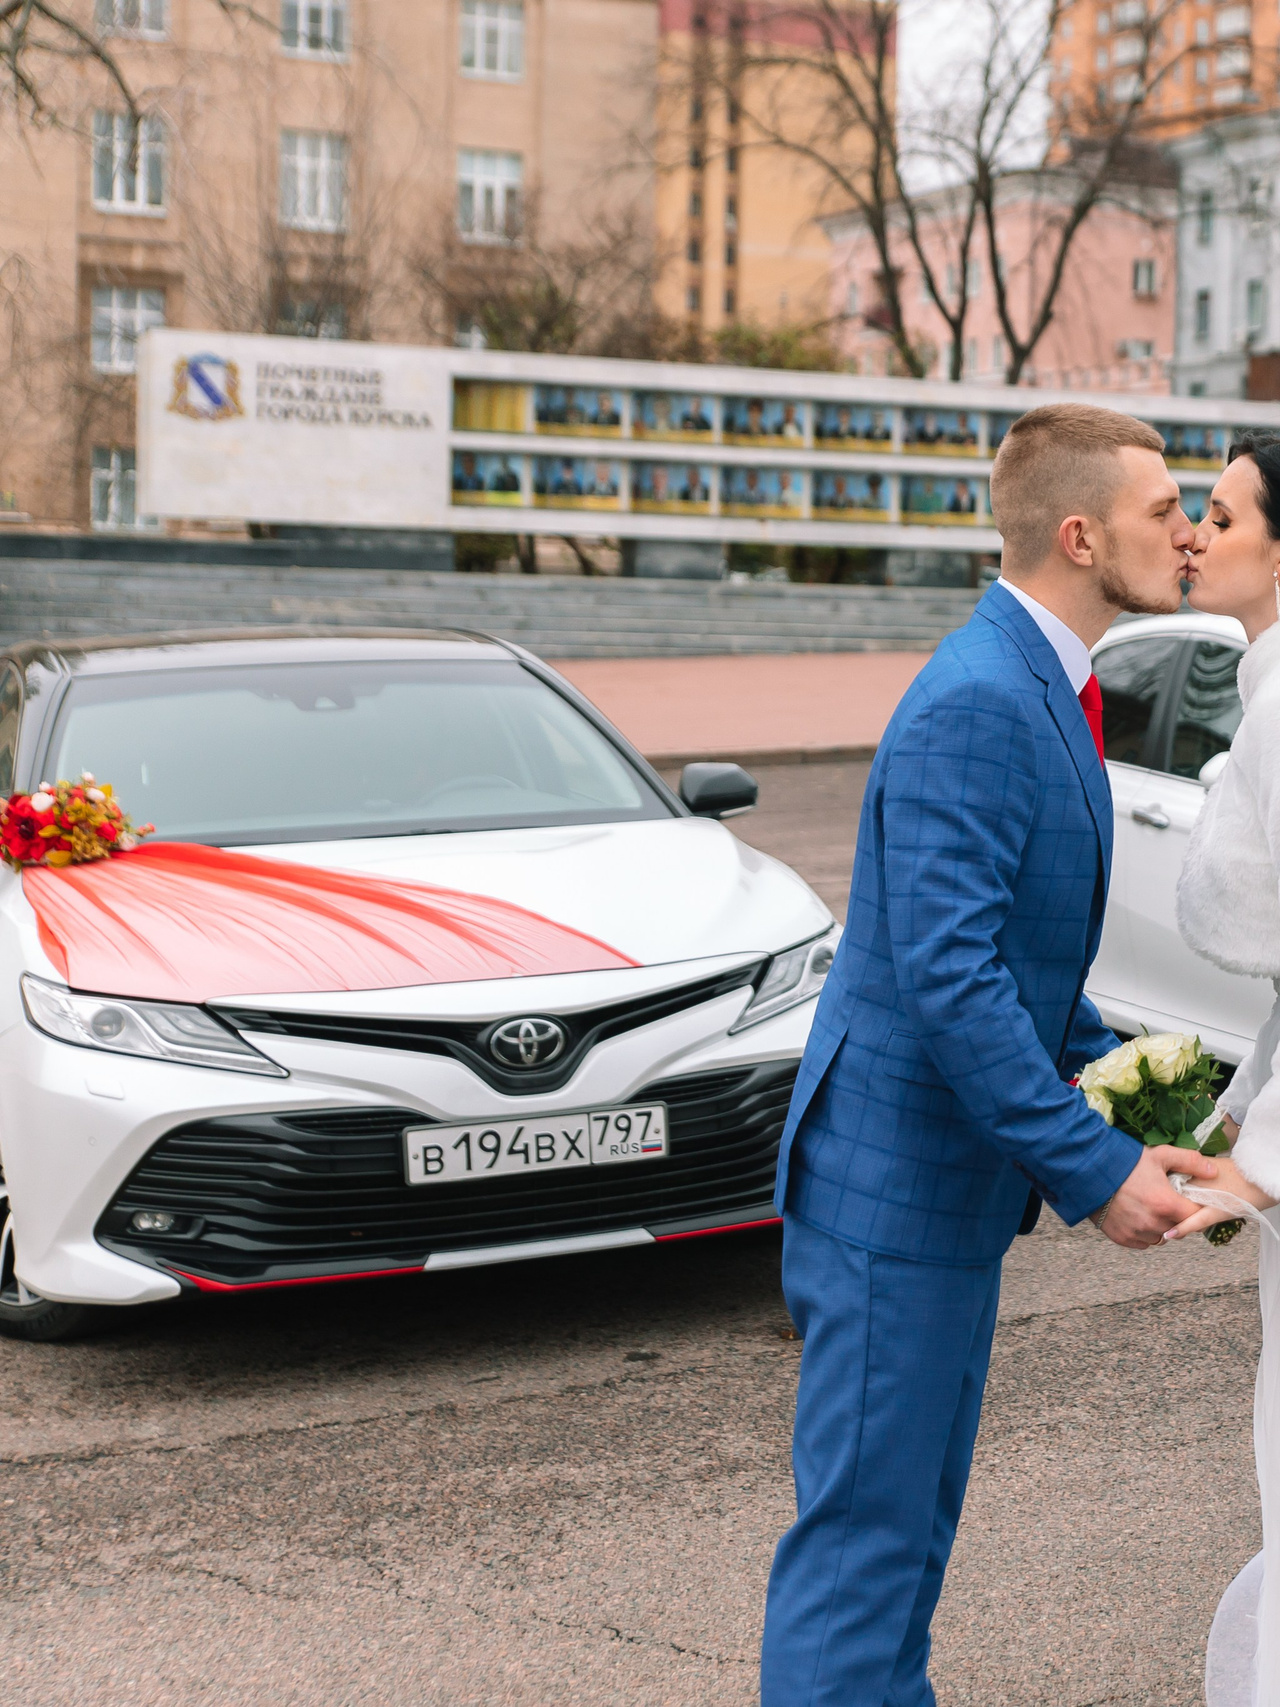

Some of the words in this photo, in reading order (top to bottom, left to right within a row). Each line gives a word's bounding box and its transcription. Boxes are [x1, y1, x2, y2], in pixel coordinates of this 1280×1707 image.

[256, 402, 344, 426] ГОРОДА
[349, 405, 434, 429] КУРСКА
[592, 1110, 653, 1146] 797
[609, 1142, 640, 1156] RUS
